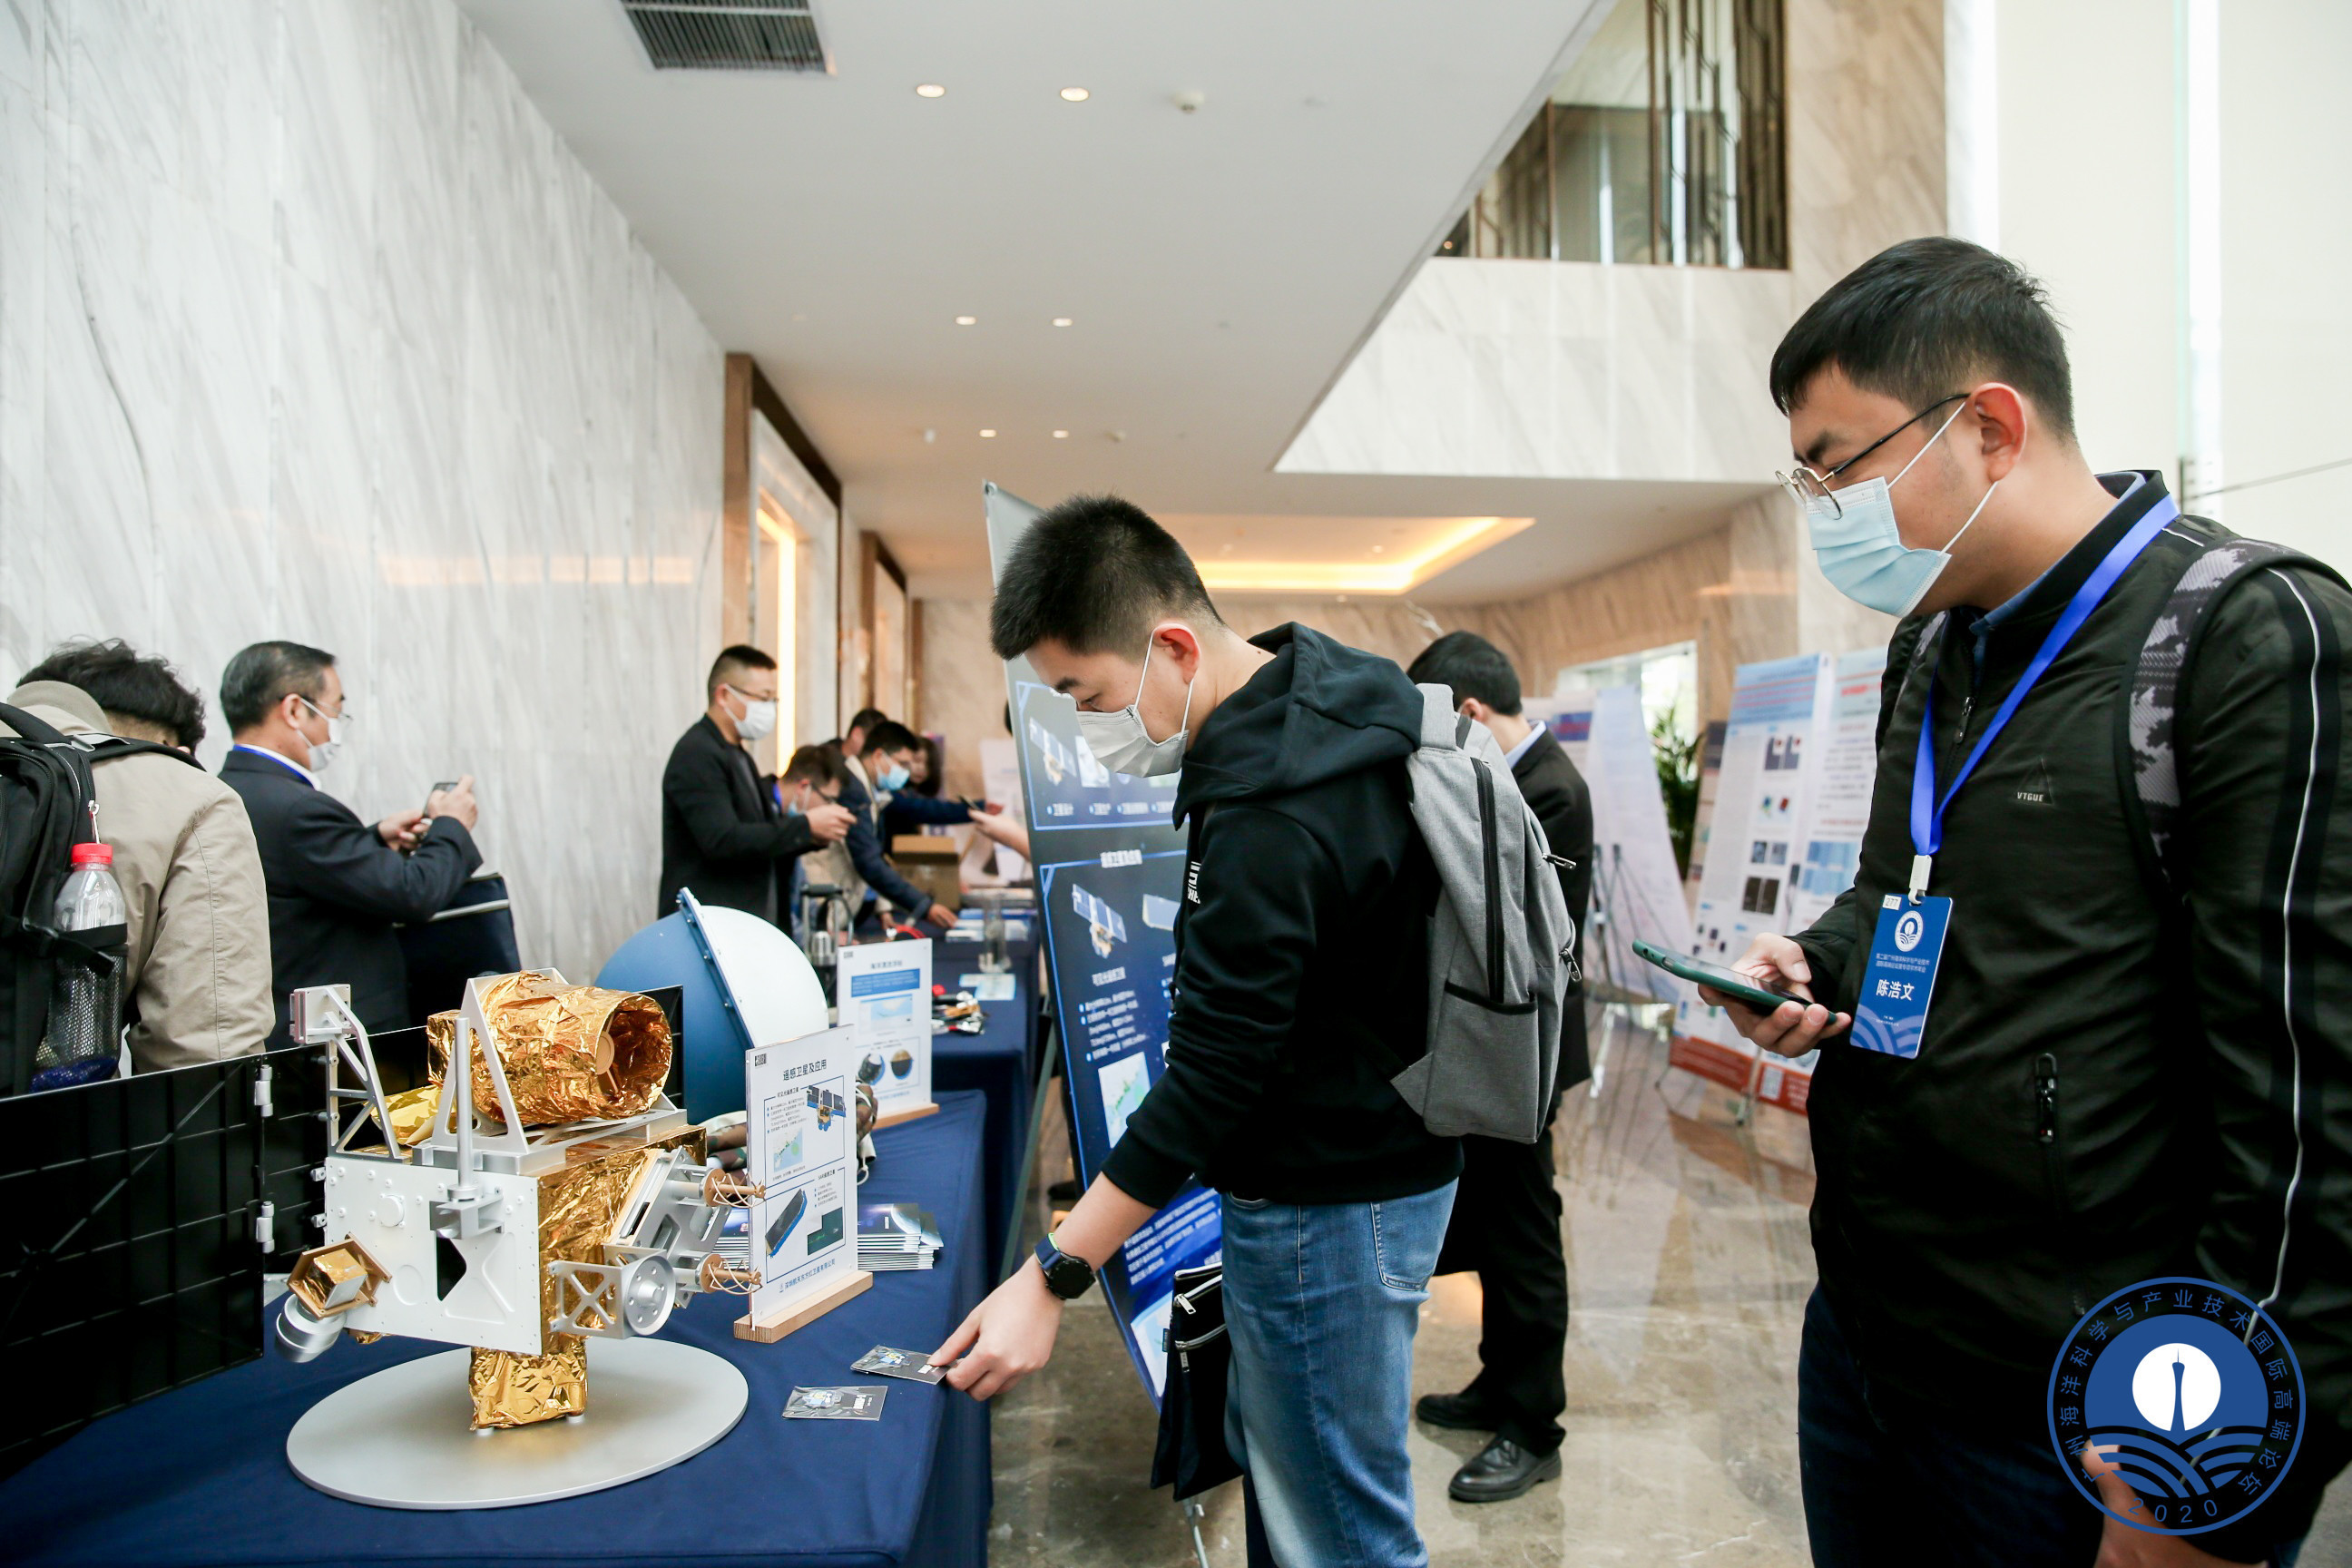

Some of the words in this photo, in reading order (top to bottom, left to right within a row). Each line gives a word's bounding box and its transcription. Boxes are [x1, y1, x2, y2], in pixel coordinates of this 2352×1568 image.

[1885, 897, 1898, 906] 277
[1876, 979, 1916, 1002] 陈浩文
[783, 1059, 828, 1081] 遥感卫星及应用
